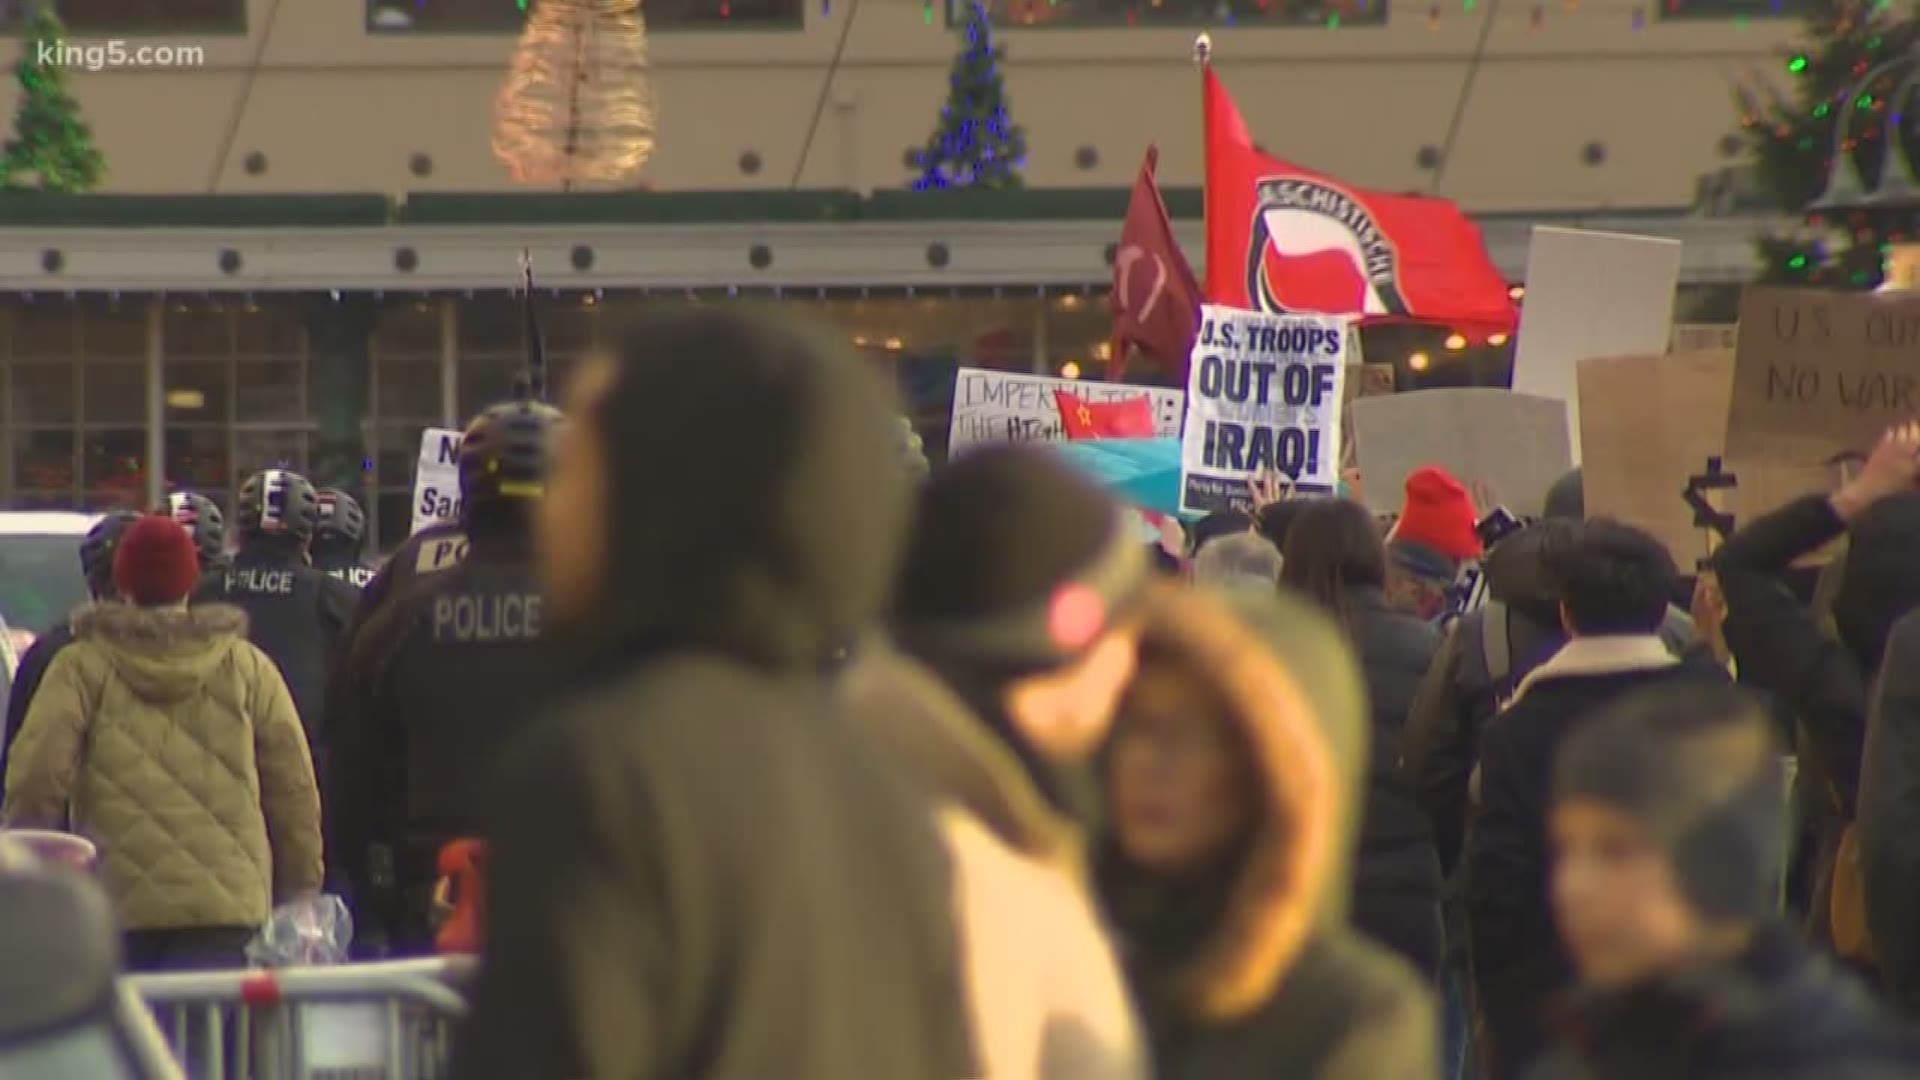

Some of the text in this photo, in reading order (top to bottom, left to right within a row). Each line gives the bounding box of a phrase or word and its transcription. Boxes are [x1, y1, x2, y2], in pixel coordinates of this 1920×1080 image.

[1247, 325, 1340, 354] TROOPS
[1200, 355, 1335, 406] OUT OF
[1766, 362, 1820, 403] NO
[1202, 420, 1320, 480] IRAQ!
[434, 595, 541, 639] POLICE
